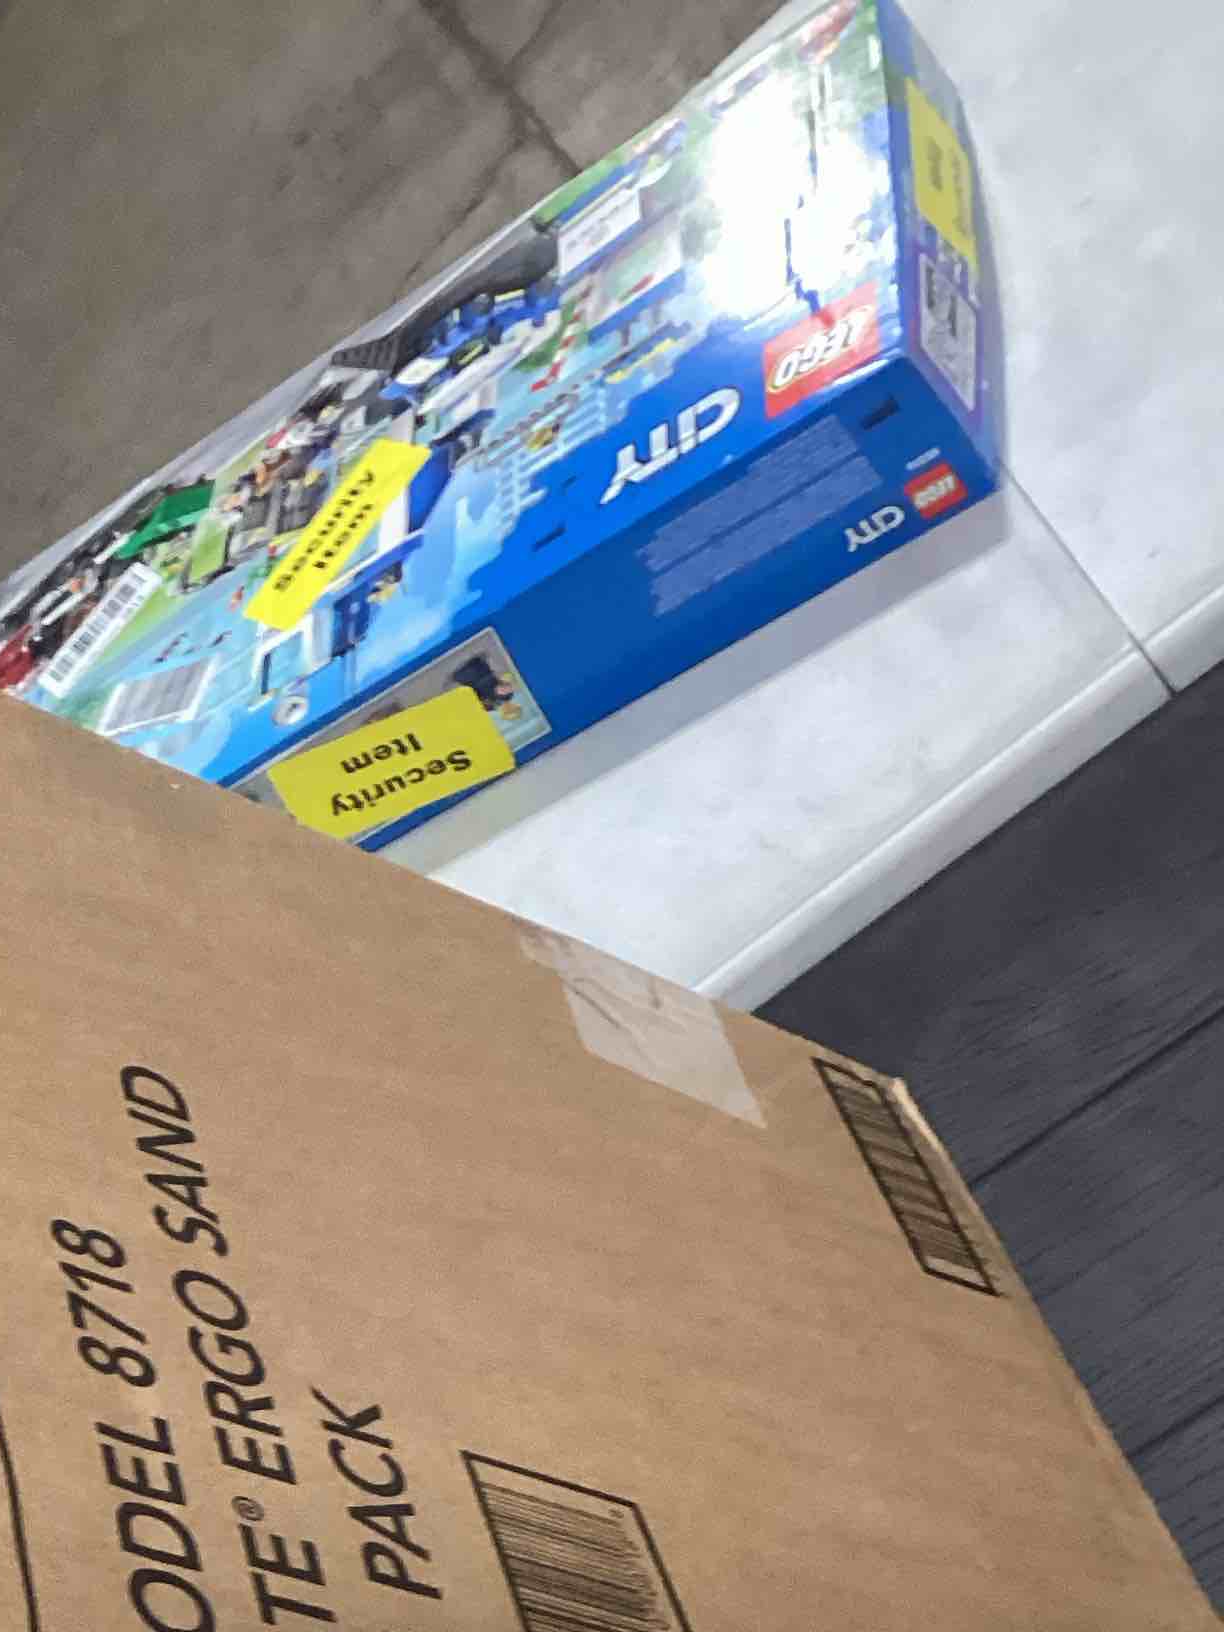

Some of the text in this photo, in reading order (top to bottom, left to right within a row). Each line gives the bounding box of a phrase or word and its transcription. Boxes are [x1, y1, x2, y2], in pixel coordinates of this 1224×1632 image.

[769, 304, 875, 394] LEGO
[601, 386, 742, 505] CITY
[843, 505, 905, 553] CITY
[330, 749, 473, 817] Security
[338, 732, 423, 774] Item
[120, 1064, 229, 1258] SAND
[50, 1218, 156, 1388] 8718
[171, 1269, 297, 1486] ERGO
[310, 1385, 444, 1600] PACK
